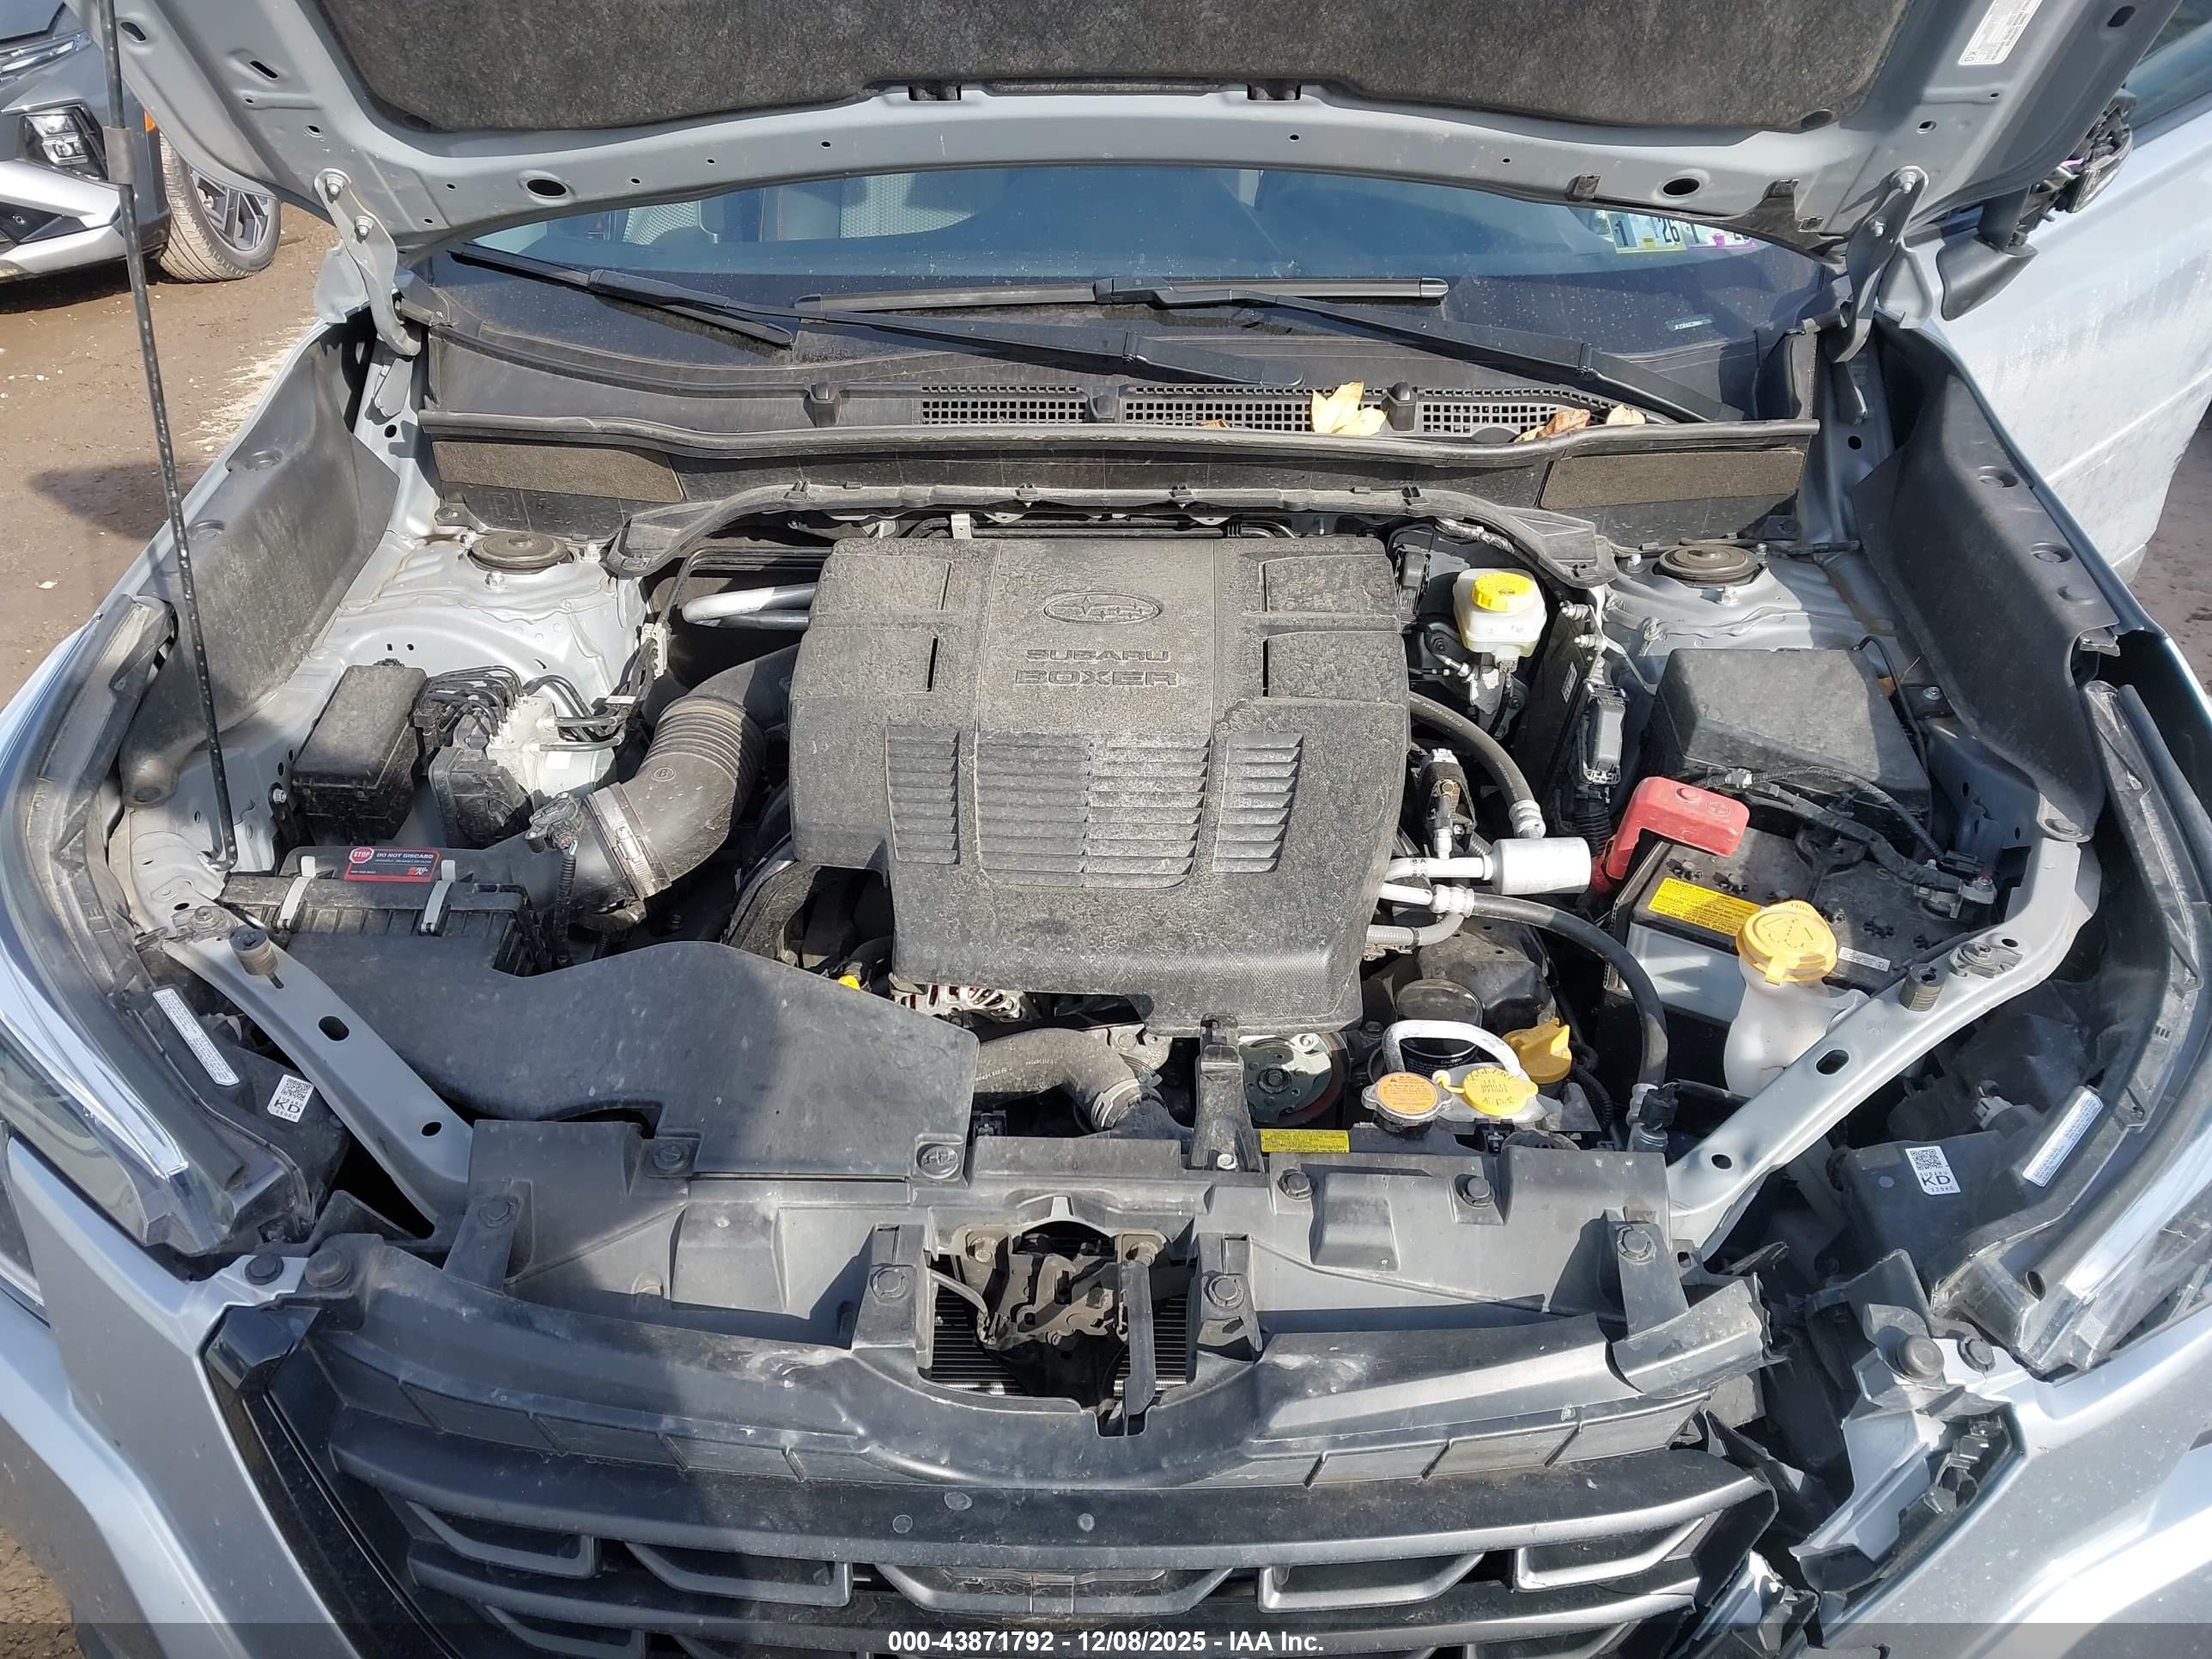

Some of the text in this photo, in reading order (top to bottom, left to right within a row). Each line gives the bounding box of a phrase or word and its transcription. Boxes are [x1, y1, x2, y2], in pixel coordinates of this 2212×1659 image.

[1614, 220, 1629, 246] 1
[1026, 649, 1170, 662] SUBARU
[1015, 670, 1179, 687] BOXER
[1656, 893, 1684, 905] POISON
[274, 1099, 301, 1114] KD
[1921, 1176, 1951, 1186] KD
